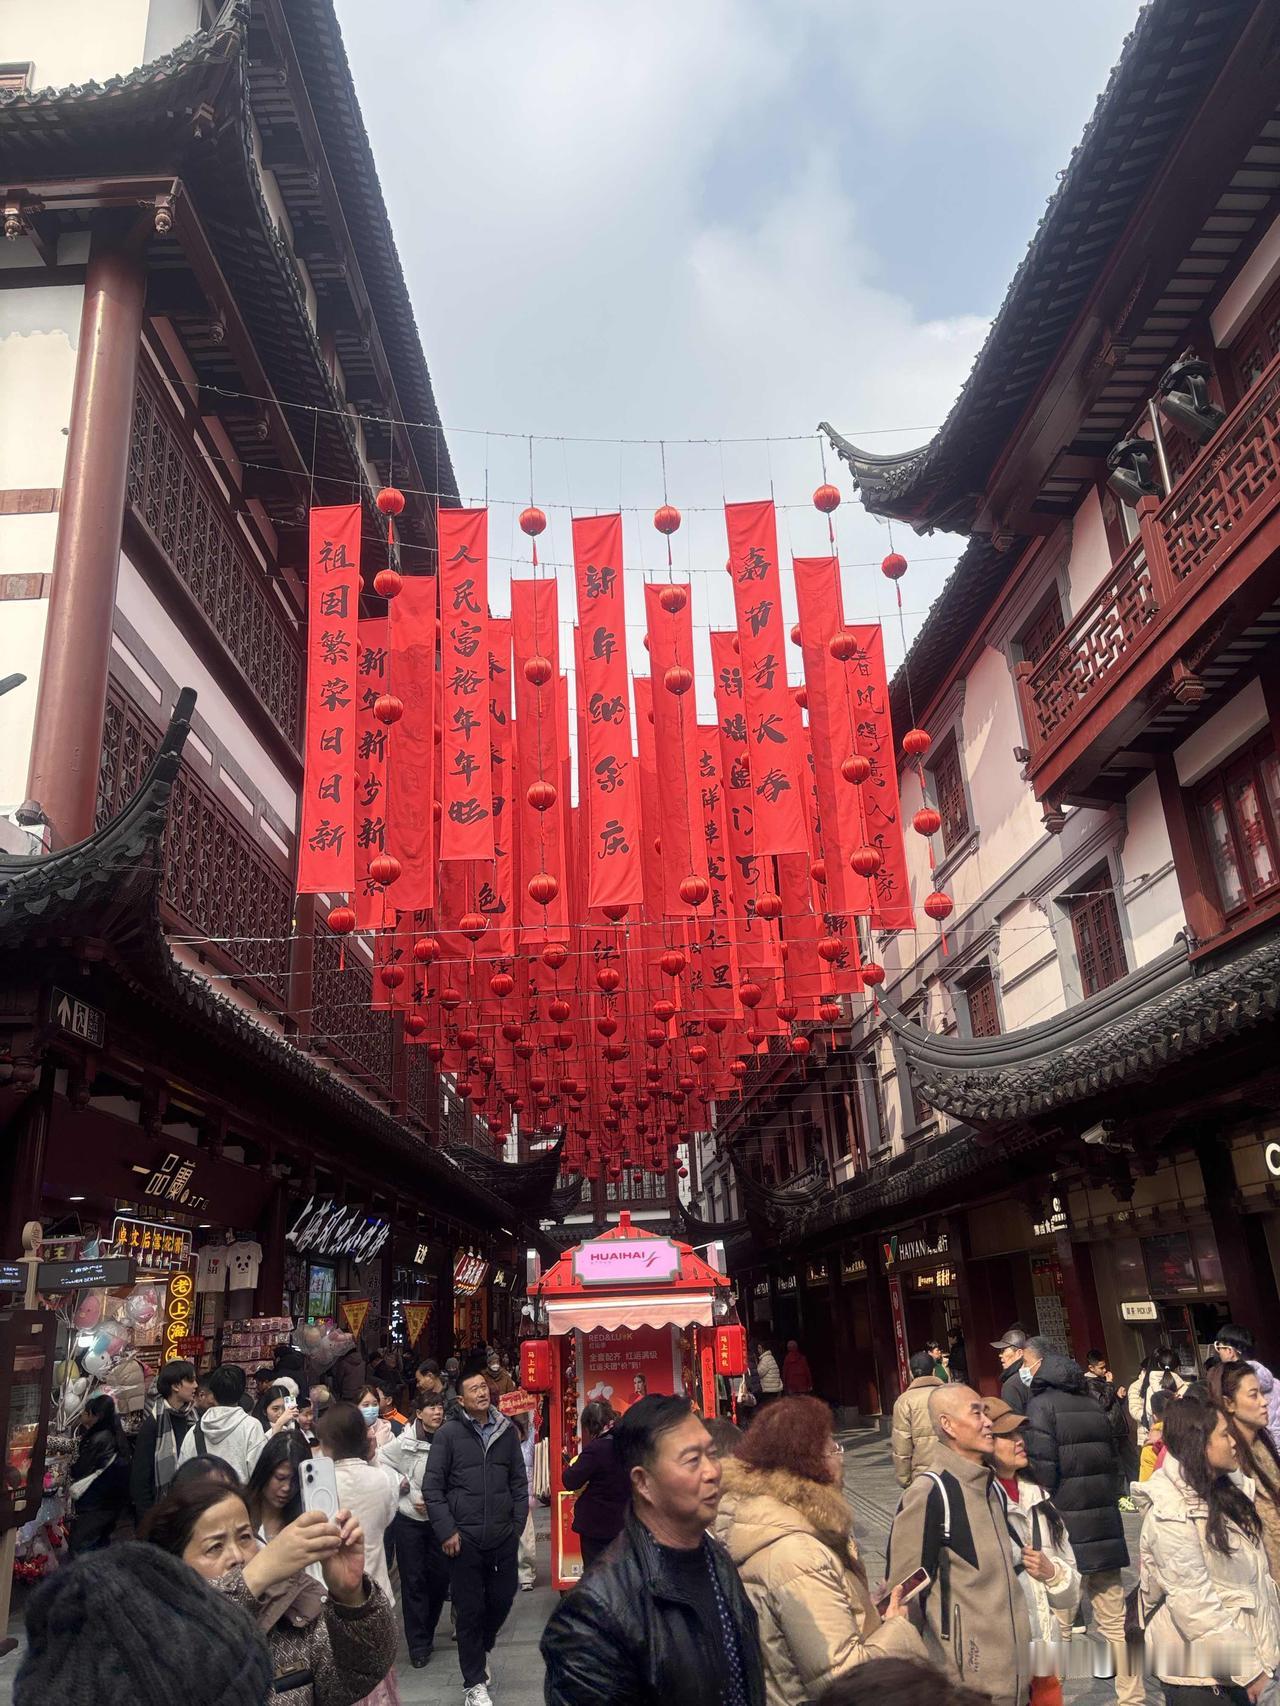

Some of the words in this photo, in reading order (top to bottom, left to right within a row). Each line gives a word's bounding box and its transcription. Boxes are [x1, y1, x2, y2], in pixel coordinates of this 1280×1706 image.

[308, 540, 355, 857] 祖国繁荣日日新
[585, 564, 630, 859] 新年纳余庆
[737, 546, 791, 803] 嘉节号长春
[590, 1251, 645, 1261] HUAIHAI
[898, 1239, 926, 1261] HAIYAN
